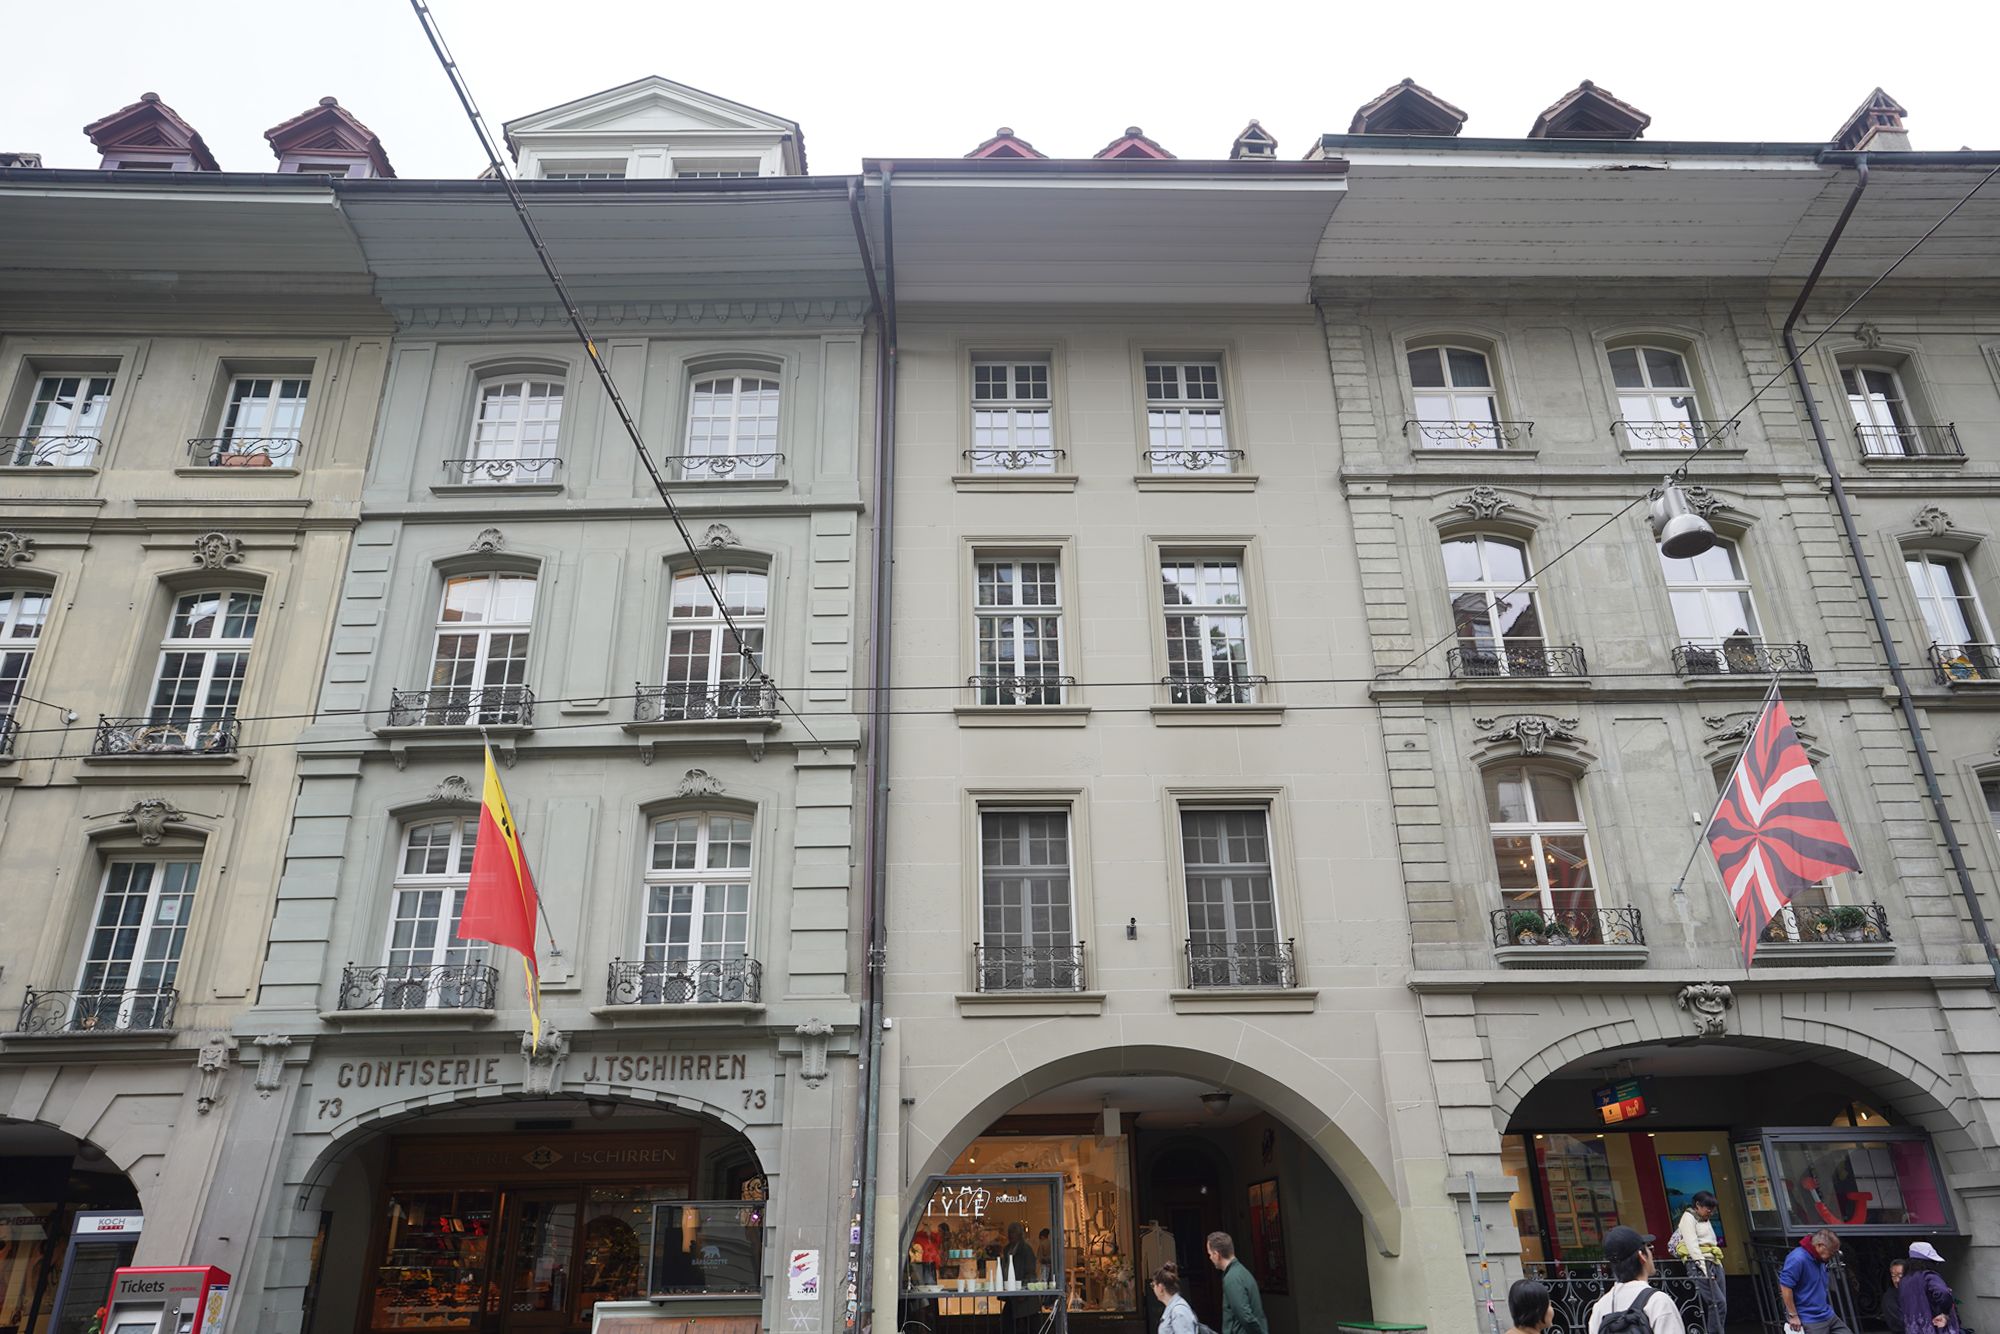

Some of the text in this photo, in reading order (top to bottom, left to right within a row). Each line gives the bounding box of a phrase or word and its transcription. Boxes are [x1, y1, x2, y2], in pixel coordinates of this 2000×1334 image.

[337, 1058, 500, 1088] CONFISERIE
[318, 1097, 343, 1119] 73
[742, 1089, 767, 1110] 73
[120, 1280, 165, 1293] Tickets
